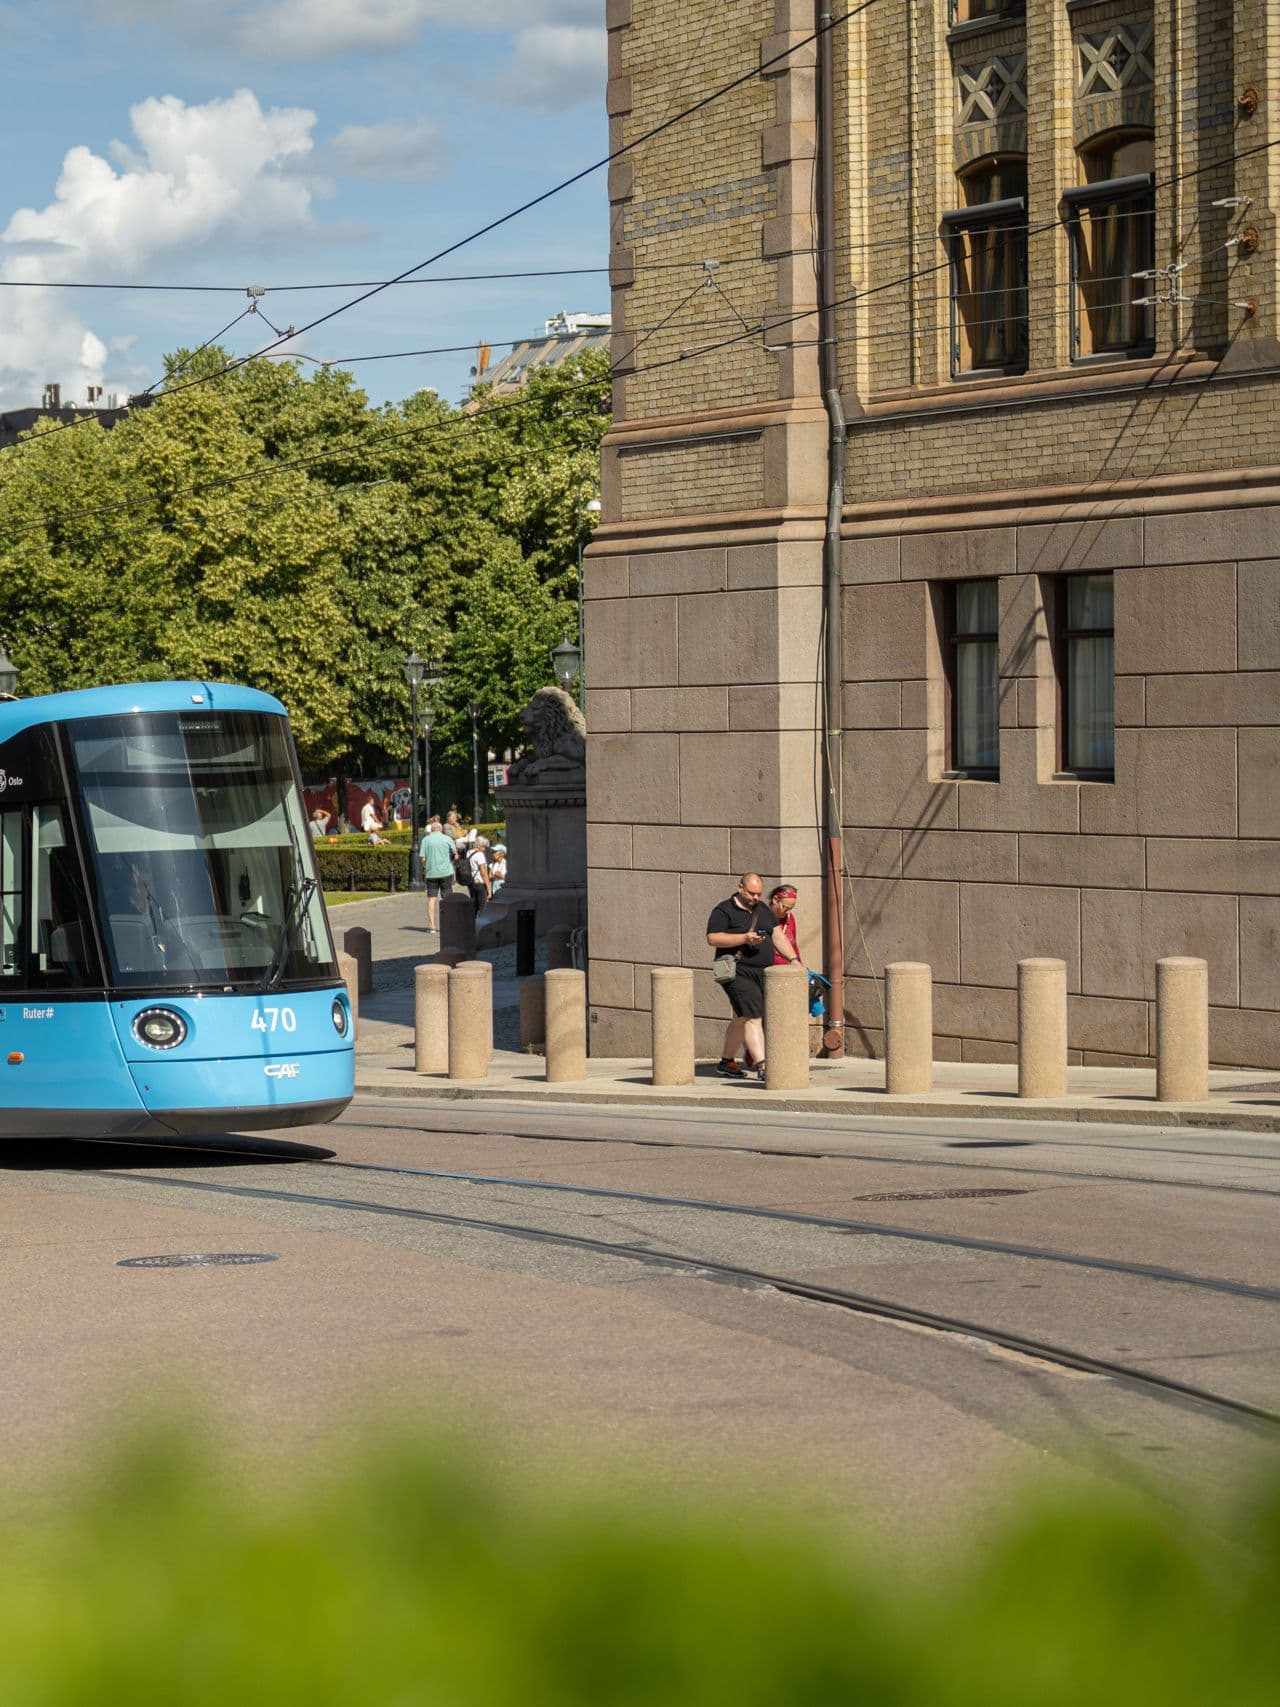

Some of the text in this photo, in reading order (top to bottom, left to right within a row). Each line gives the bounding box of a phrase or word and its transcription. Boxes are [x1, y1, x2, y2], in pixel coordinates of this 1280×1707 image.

[8, 776, 23, 786] Oslo
[251, 1007, 298, 1032] 470
[263, 1063, 301, 1079] CAF
